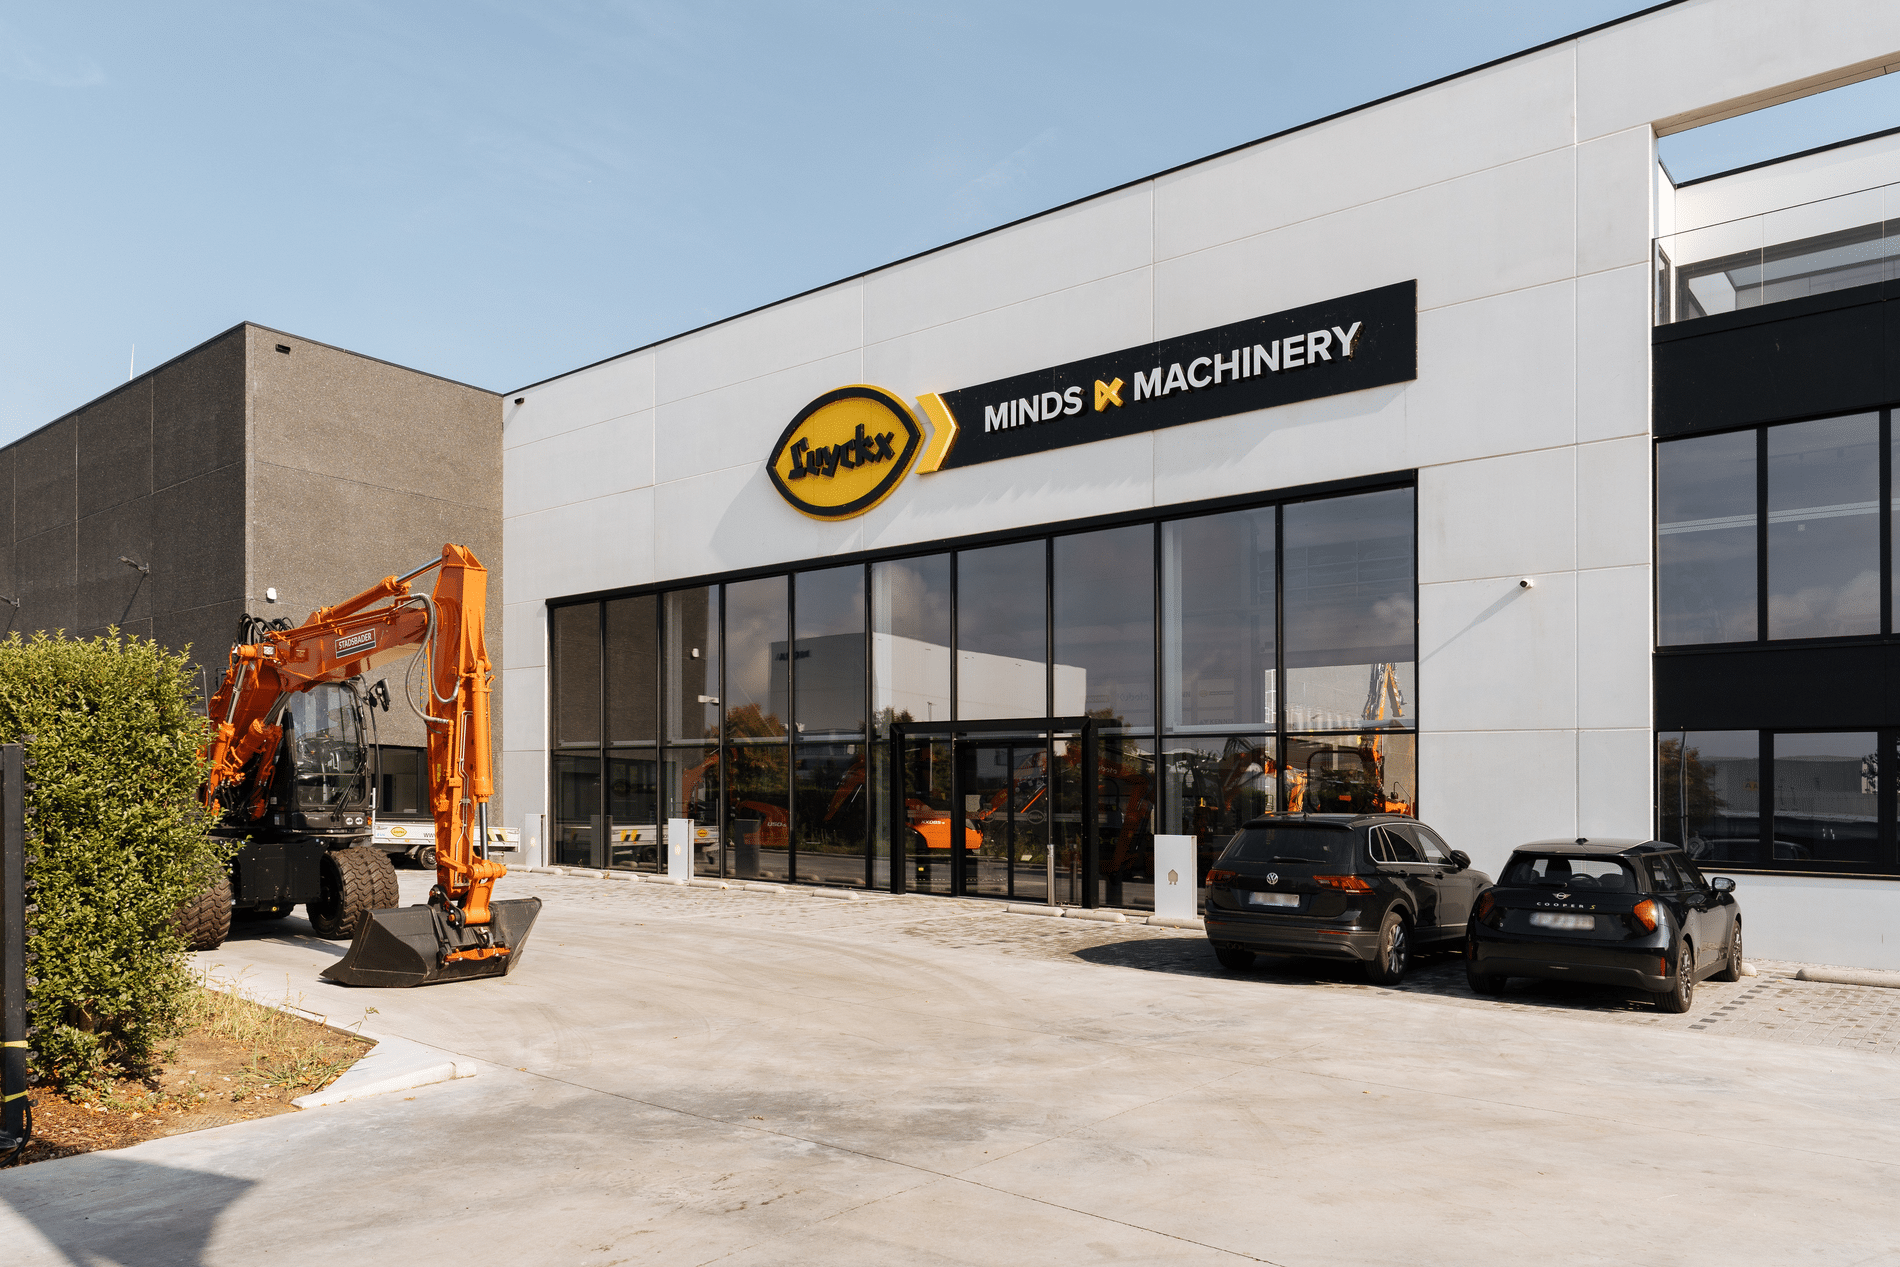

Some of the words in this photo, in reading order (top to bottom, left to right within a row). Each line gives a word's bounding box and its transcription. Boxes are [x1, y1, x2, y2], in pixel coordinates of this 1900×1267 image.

[984, 385, 1084, 433] MINDS
[1133, 321, 1363, 402] MACHINERY
[338, 632, 372, 650] STADSBADER
[1536, 901, 1584, 909] COOPER
